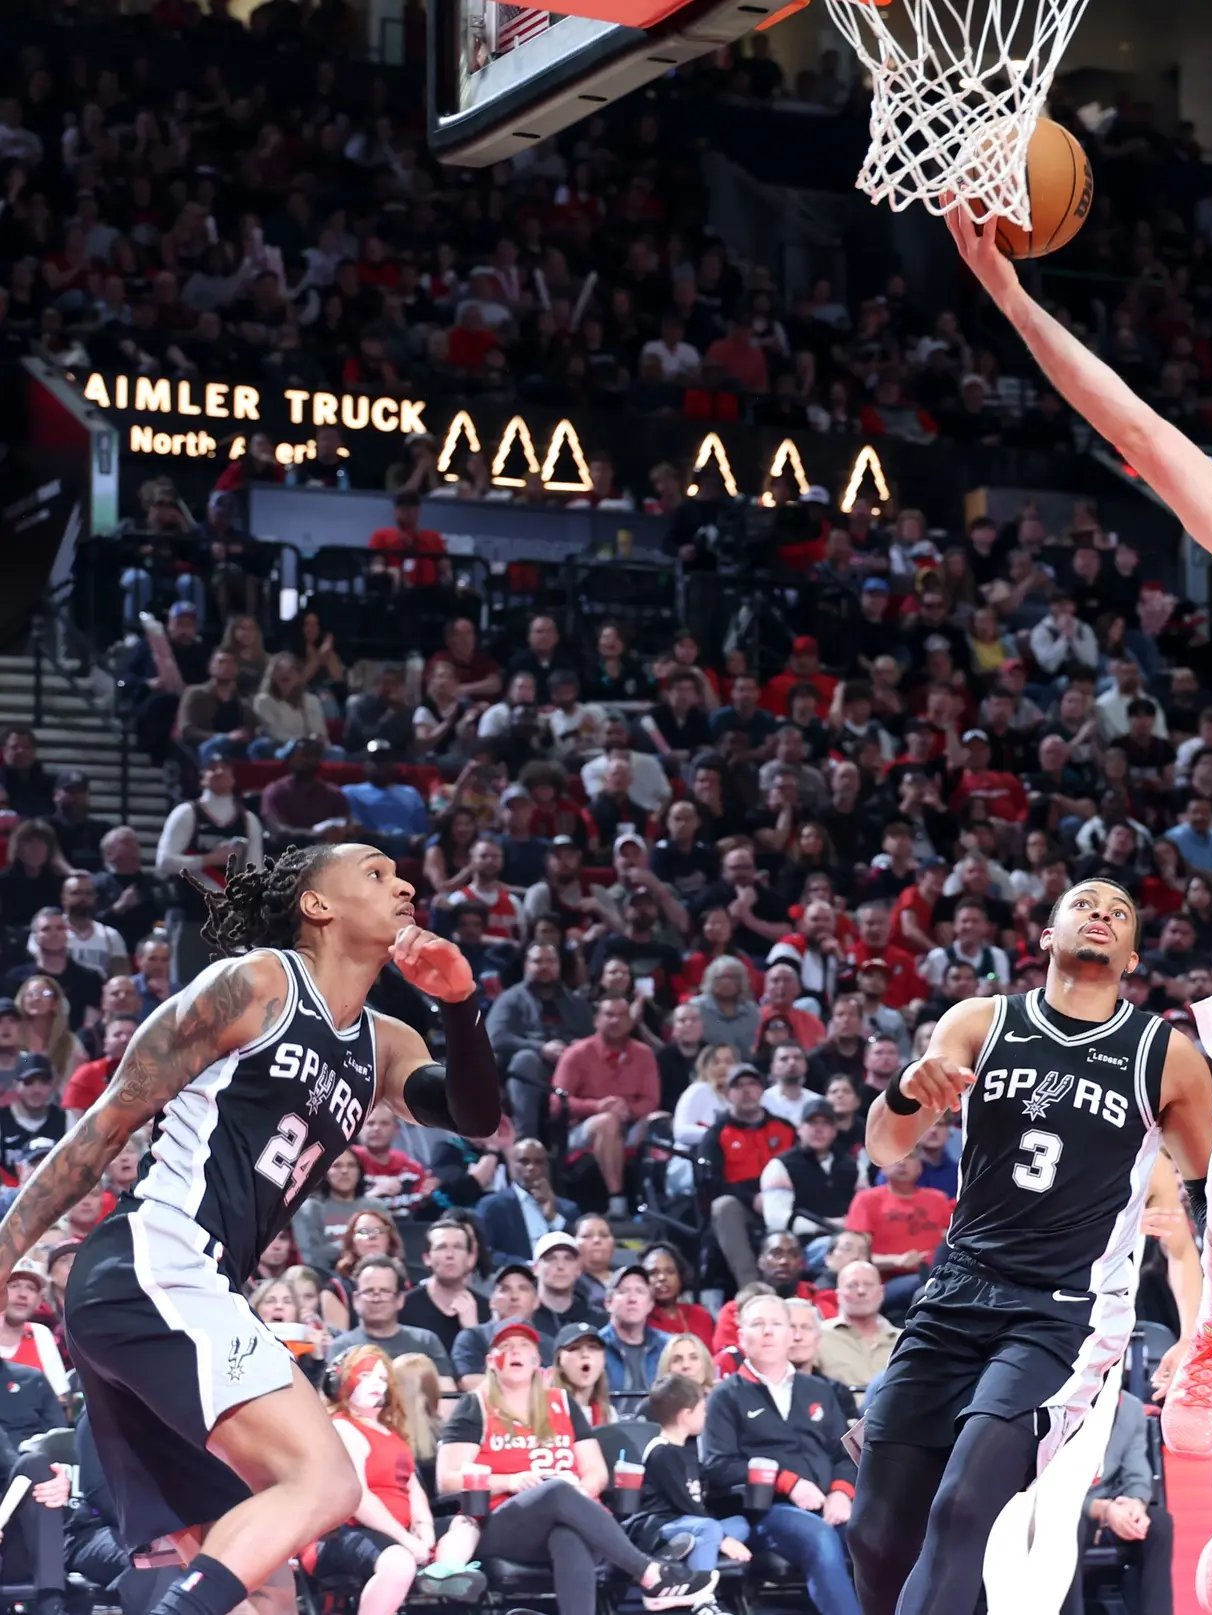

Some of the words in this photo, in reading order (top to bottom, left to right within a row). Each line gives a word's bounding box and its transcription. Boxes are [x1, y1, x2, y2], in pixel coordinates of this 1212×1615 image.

[284, 389, 427, 435] TRUCK
[129, 424, 217, 458] North
[1091, 1051, 1125, 1067] LEDGER
[269, 1042, 363, 1142] SPURS
[983, 1068, 1129, 1129] SPURS
[254, 1111, 326, 1207] 24
[1012, 1128, 1064, 1193] 3
[528, 1448, 575, 1476] 22
